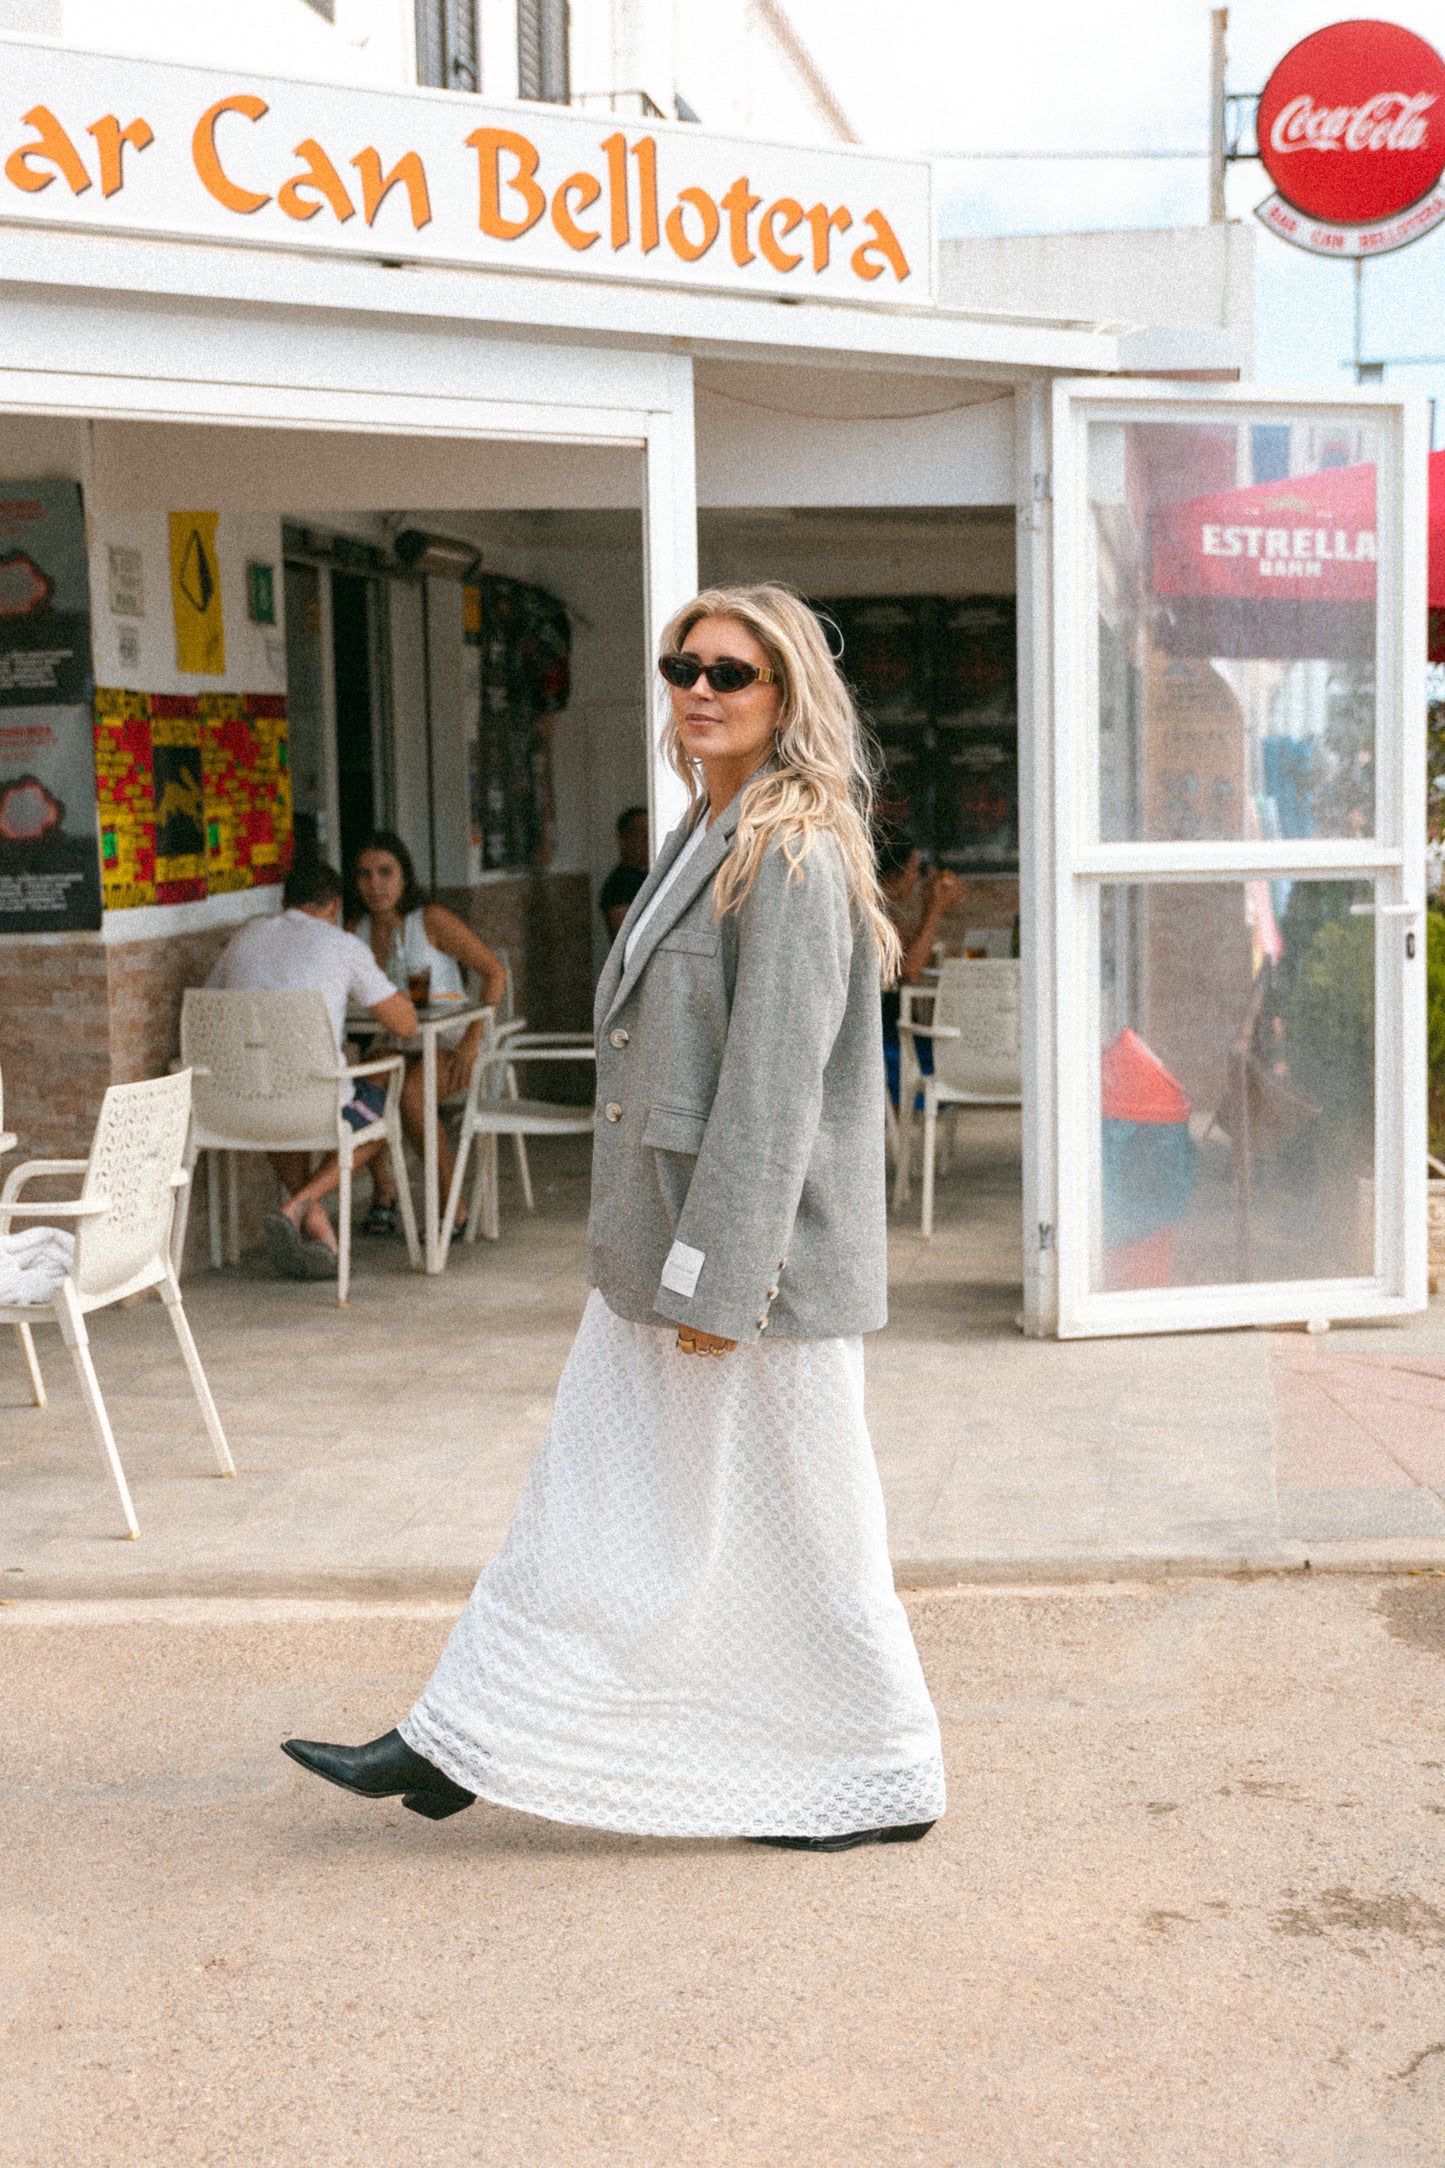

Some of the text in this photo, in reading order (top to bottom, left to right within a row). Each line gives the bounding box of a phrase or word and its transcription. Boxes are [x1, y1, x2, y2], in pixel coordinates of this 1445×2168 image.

[192, 94, 432, 231] Can
[464, 127, 911, 283] Bellotera
[1310, 228, 1344, 250] CAN
[1201, 523, 1377, 562] ESTRELLA
